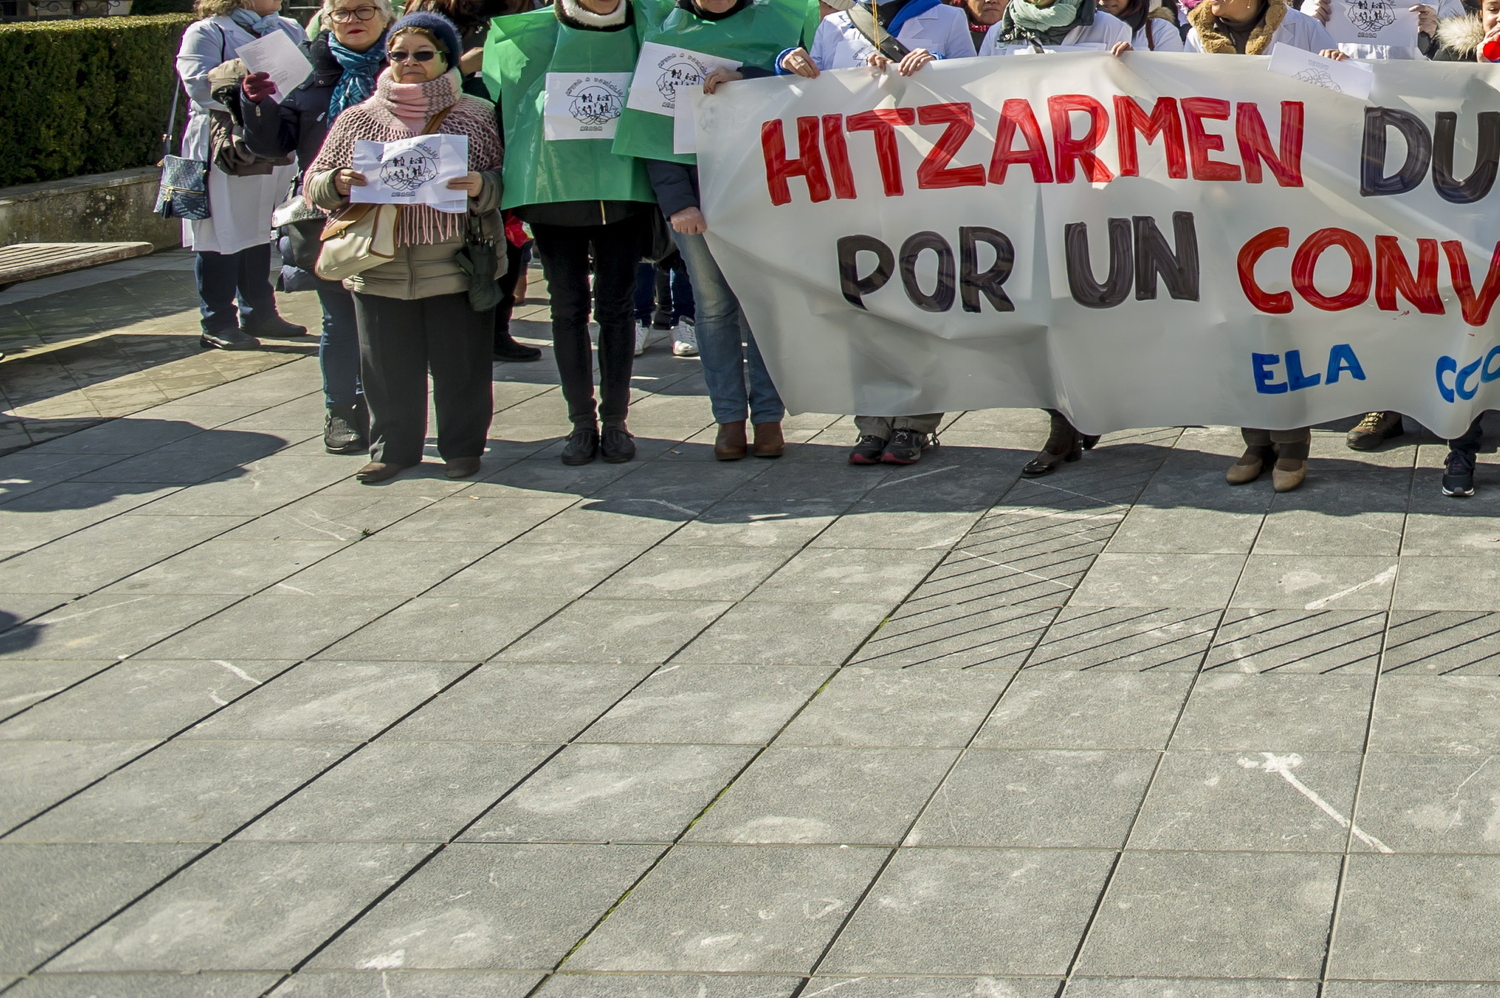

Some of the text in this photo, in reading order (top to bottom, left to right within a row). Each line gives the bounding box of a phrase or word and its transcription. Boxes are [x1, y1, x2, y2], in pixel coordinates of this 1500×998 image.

[762, 95, 1304, 206] HITZARMEN
[837, 227, 1015, 313] POR
[1065, 211, 1199, 309] UN
[1252, 344, 1366, 394] ELA
